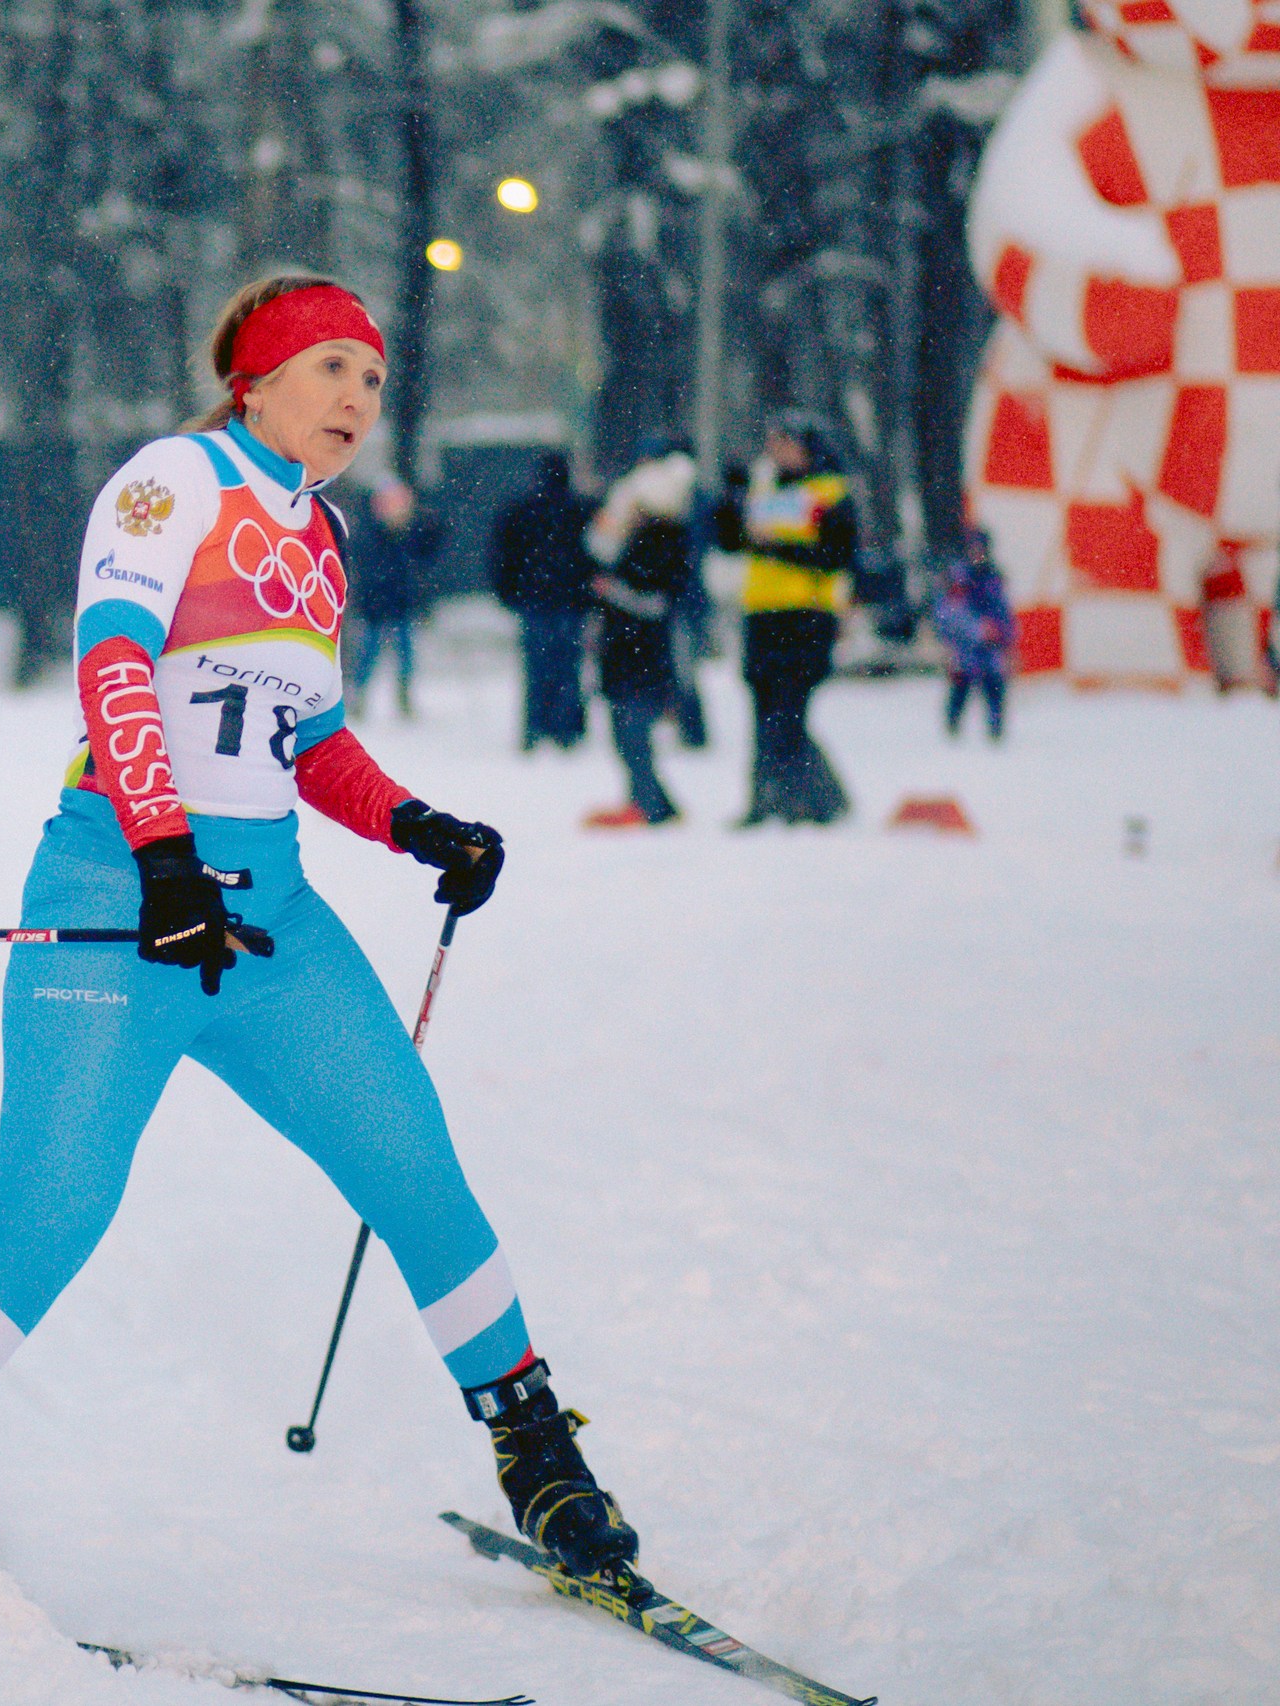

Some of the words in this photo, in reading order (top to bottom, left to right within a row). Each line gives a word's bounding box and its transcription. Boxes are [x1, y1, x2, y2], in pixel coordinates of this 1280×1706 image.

[114, 568, 163, 593] GAZPROM
[197, 655, 301, 696] torino
[189, 683, 297, 770] 18
[154, 922, 205, 946] MADSHUS
[33, 987, 127, 1006] PROTEAM
